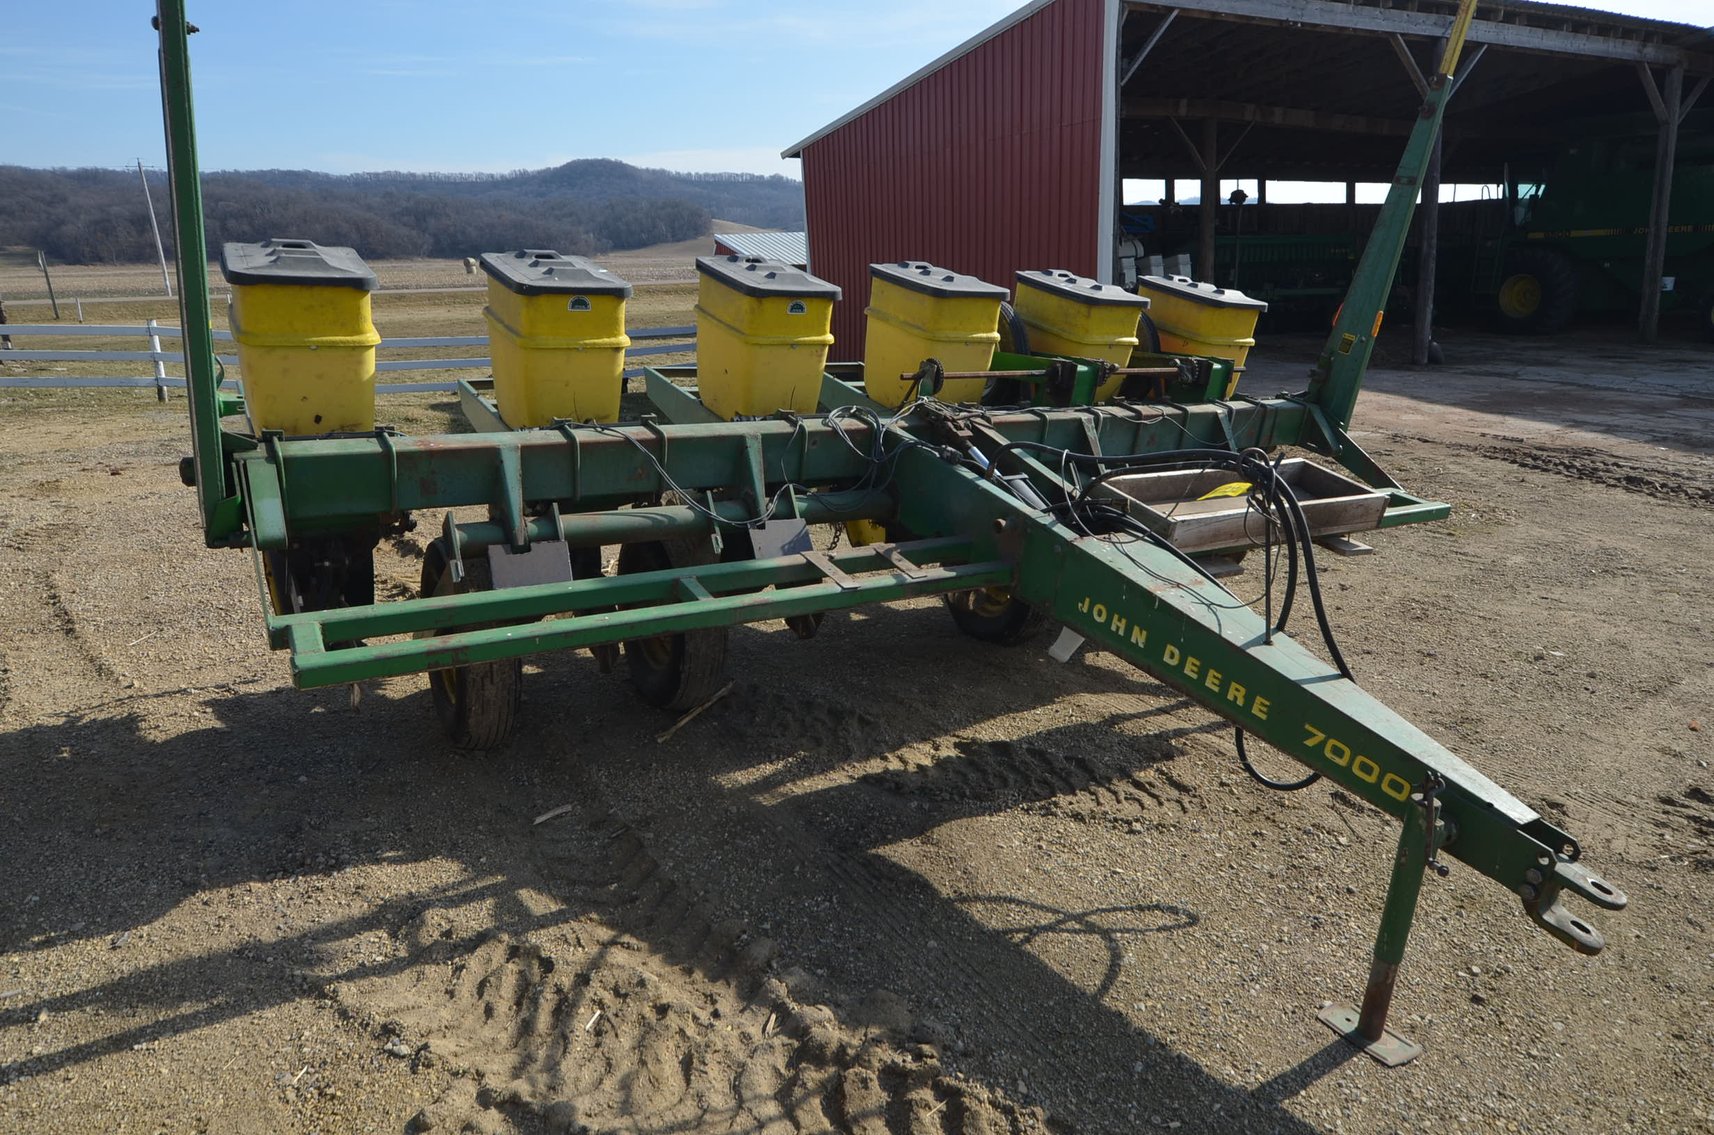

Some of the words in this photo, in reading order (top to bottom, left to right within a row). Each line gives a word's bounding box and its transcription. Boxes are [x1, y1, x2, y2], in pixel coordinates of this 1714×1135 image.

[1078, 597, 1147, 648] JOHN
[1162, 644, 1272, 720] DEERE
[1302, 723, 1412, 801] 7000
